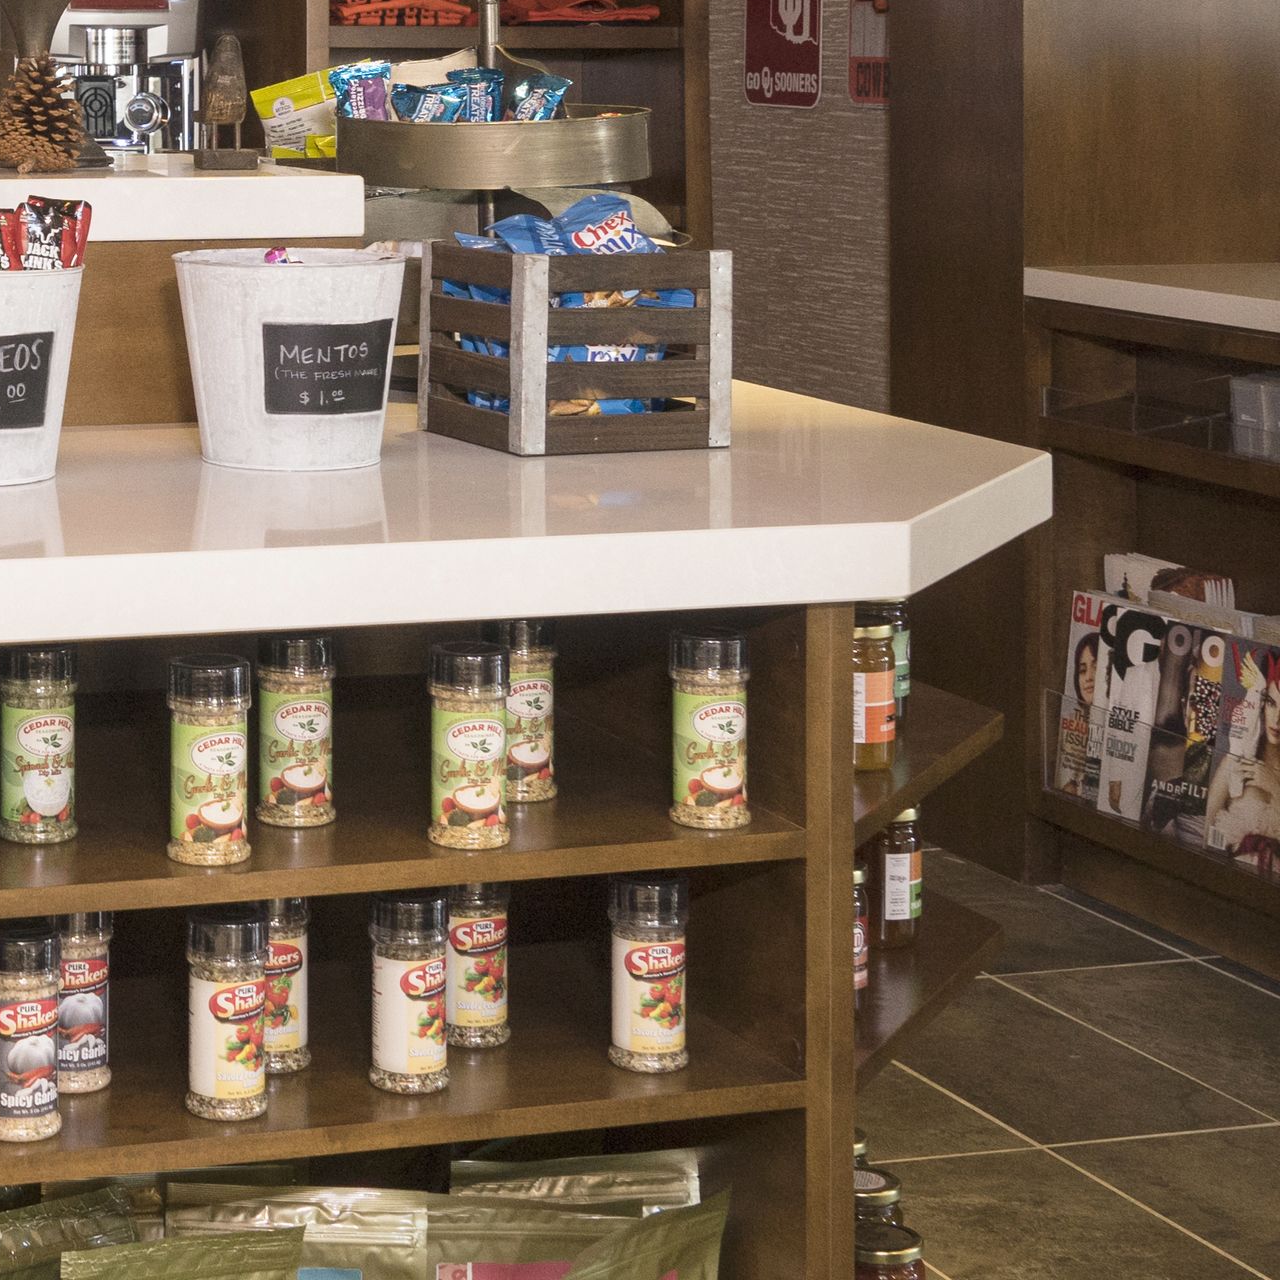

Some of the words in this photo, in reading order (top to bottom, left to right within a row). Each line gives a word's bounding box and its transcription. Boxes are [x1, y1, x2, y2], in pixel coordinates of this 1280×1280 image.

[747, 72, 760, 90] GO
[775, 72, 818, 94] SOONERS
[571, 211, 633, 249] Chex
[592, 224, 641, 254] mix
[26, 243, 60, 258] JACK
[279, 341, 369, 365] MENTOS
[314, 370, 352, 381] FRESH
[280, 704, 313, 720] CEDAR
[314, 704, 329, 718] HILL
[698, 705, 732, 721] CEDAR
[1111, 706, 1140, 720] STYLE
[23, 719, 56, 734] CEDAR
[57, 719, 72, 732] HILL
[451, 723, 485, 738] CEDAR
[487, 724, 502, 737] HILL
[1108, 717, 1135, 734] BIBLE
[1106, 736, 1138, 755] DIDDY
[19, 1004, 39, 1013] PURE
[0, 1092, 33, 1109] Spicy
